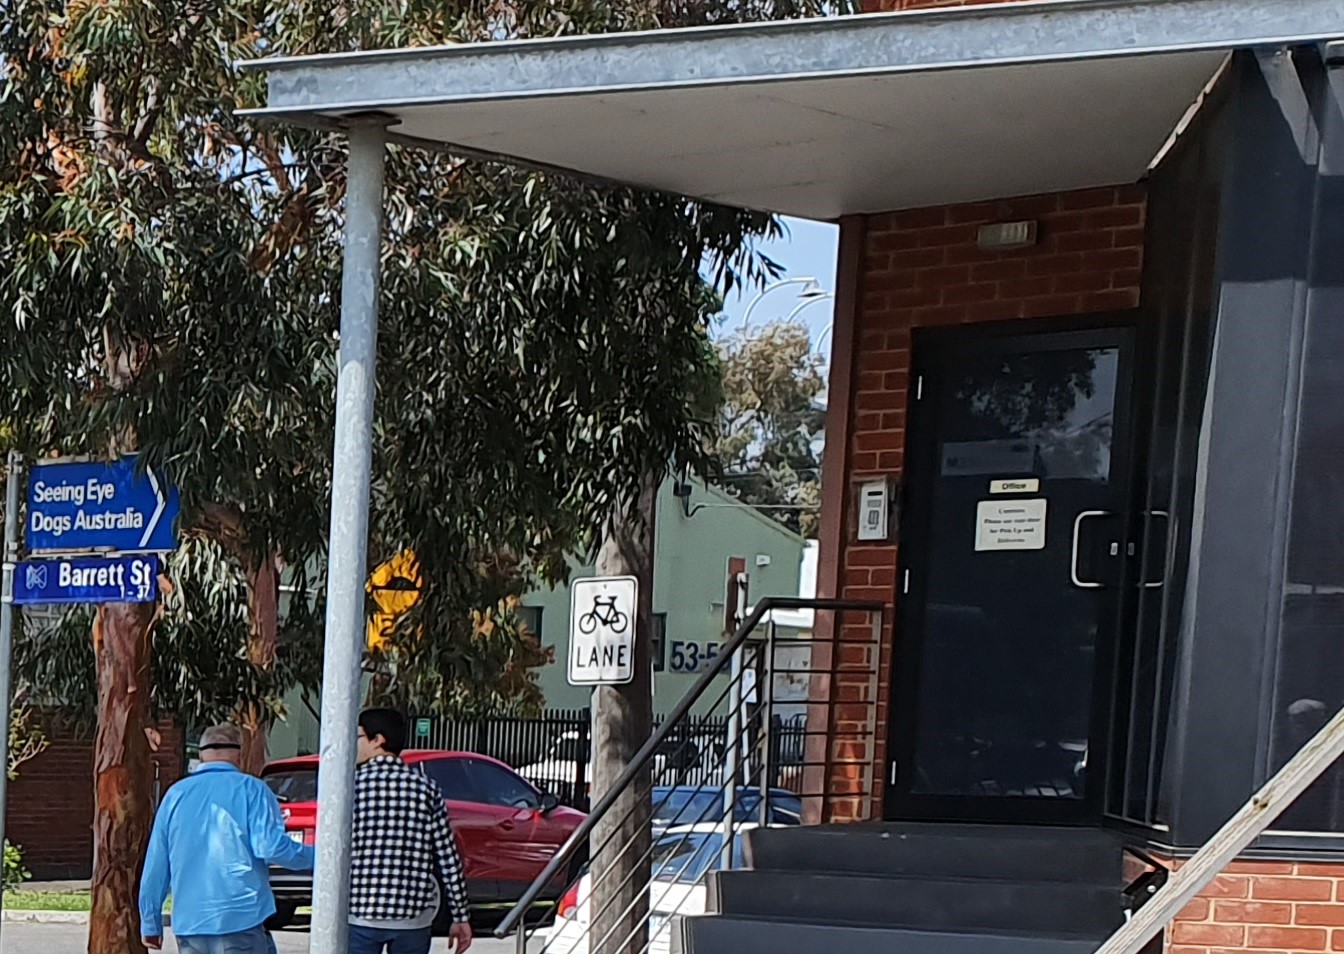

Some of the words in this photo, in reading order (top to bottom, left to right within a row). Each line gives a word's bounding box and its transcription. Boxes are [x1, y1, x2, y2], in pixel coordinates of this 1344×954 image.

[33, 480, 85, 505] Seeing
[87, 478, 115, 504] Eye
[31, 511, 72, 536] Dogs
[73, 507, 143, 531] Australia
[58, 562, 125, 587] Barrett
[130, 560, 151, 587] St
[576, 645, 627, 668] LANE
